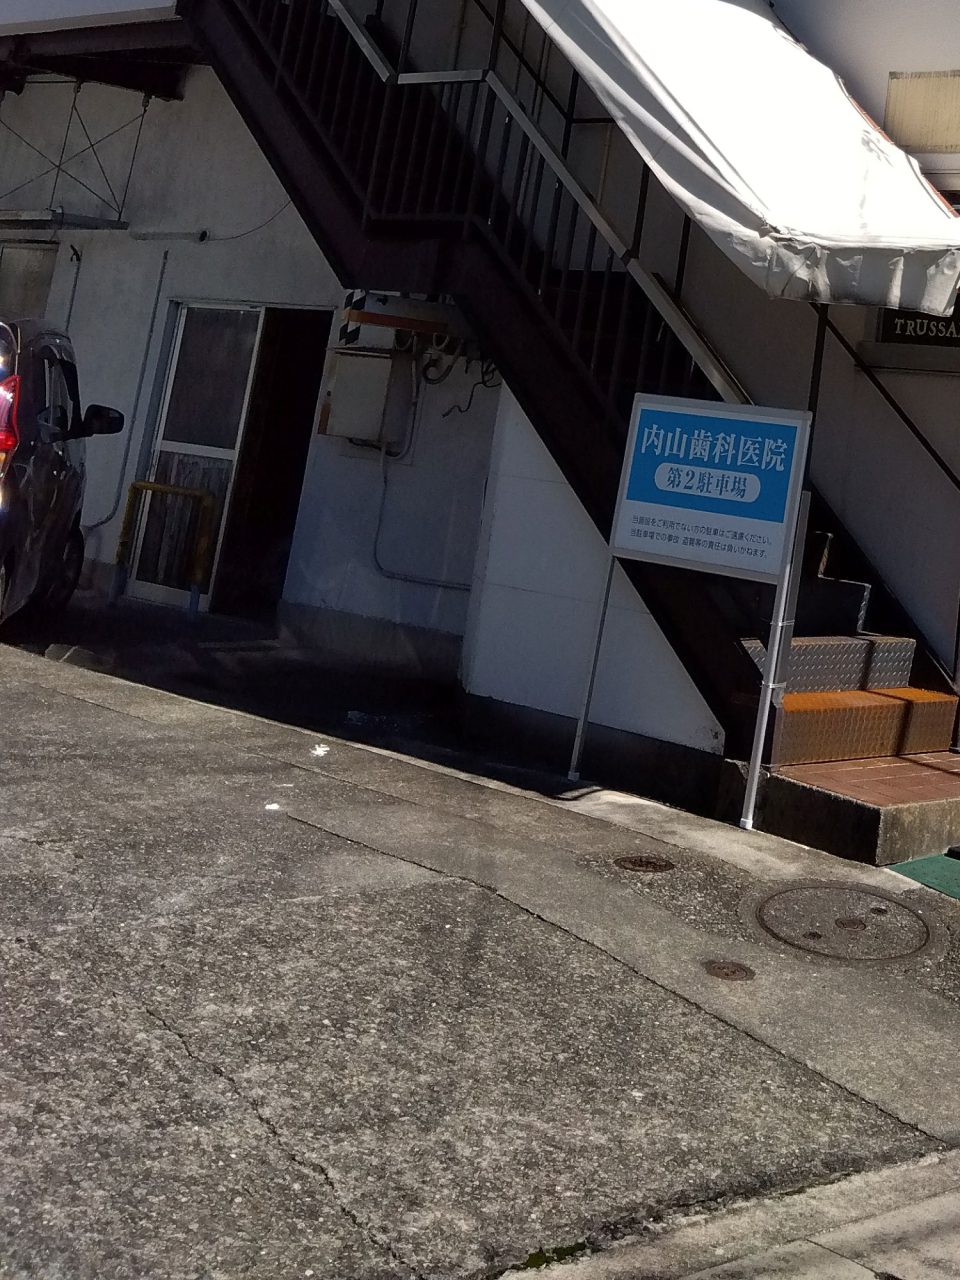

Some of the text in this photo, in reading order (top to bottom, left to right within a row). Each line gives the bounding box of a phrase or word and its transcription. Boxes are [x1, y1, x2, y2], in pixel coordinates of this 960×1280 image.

[641, 424, 788, 471] 内山歯科医院
[665, 467, 748, 499] 第2駐車場
